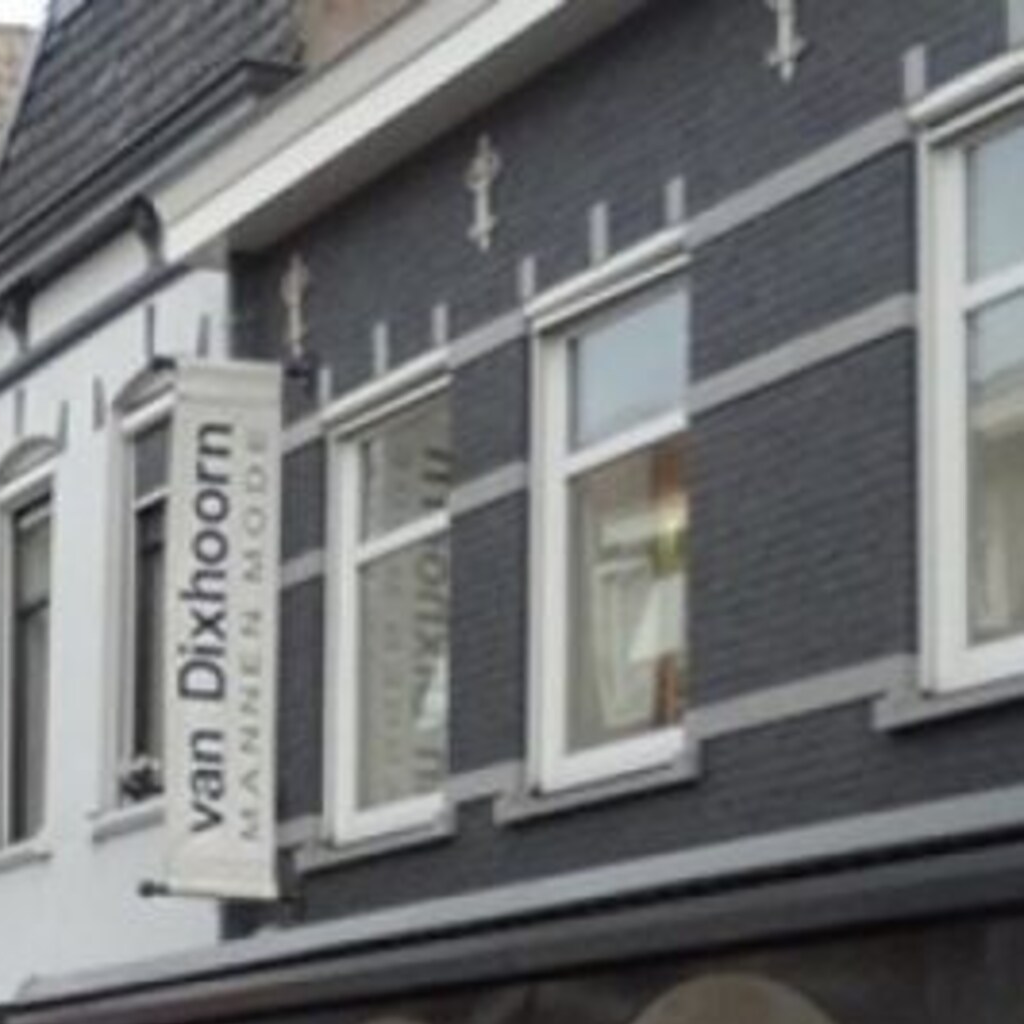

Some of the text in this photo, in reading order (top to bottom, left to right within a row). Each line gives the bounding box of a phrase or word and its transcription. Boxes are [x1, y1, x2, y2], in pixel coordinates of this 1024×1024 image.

[178, 422, 233, 833] van Dixhoorn
[240, 431, 268, 841] MANNEN MODE
